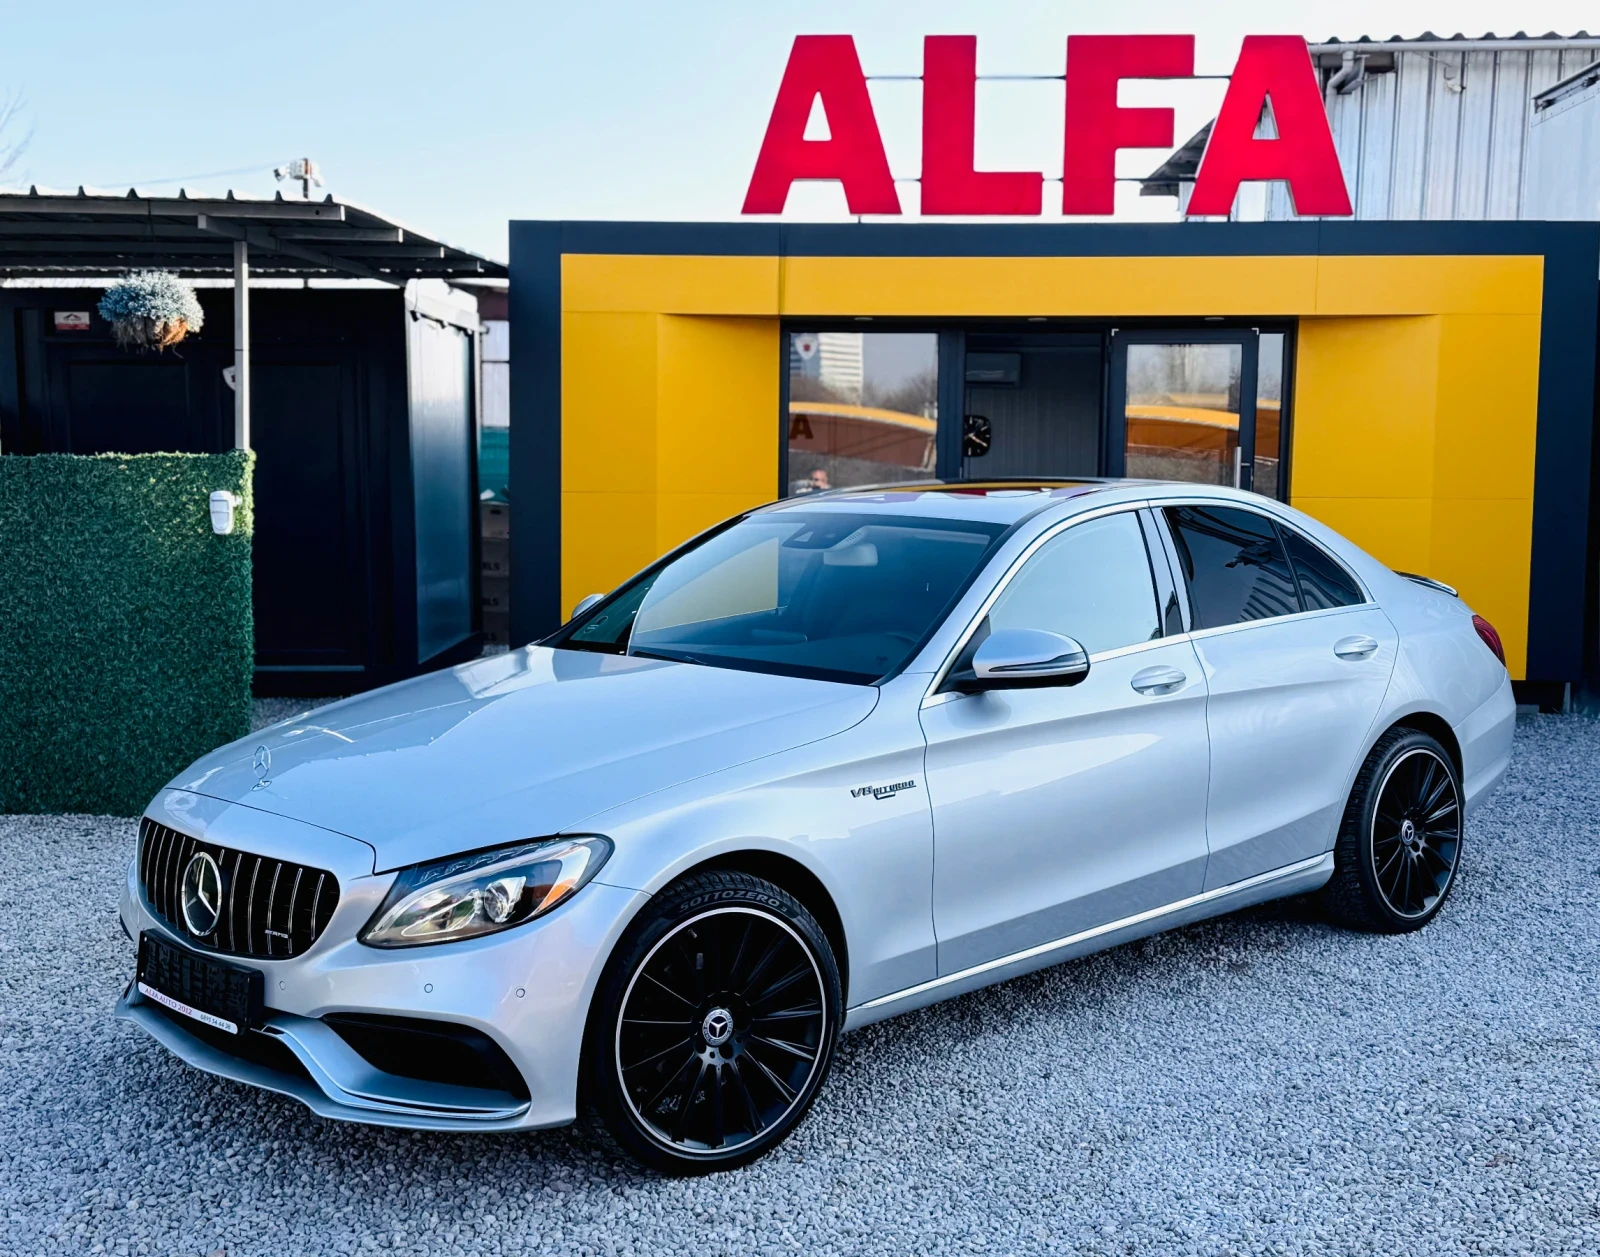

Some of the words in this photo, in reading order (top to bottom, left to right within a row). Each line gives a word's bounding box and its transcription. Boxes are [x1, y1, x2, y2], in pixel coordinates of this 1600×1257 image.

[741, 34, 1353, 216] ALFA
[680, 890, 780, 912] SOTTOZERO
[144, 988, 159, 1000] ALFA
[159, 995, 177, 1008] AUTO
[178, 1004, 193, 1015] 2012
